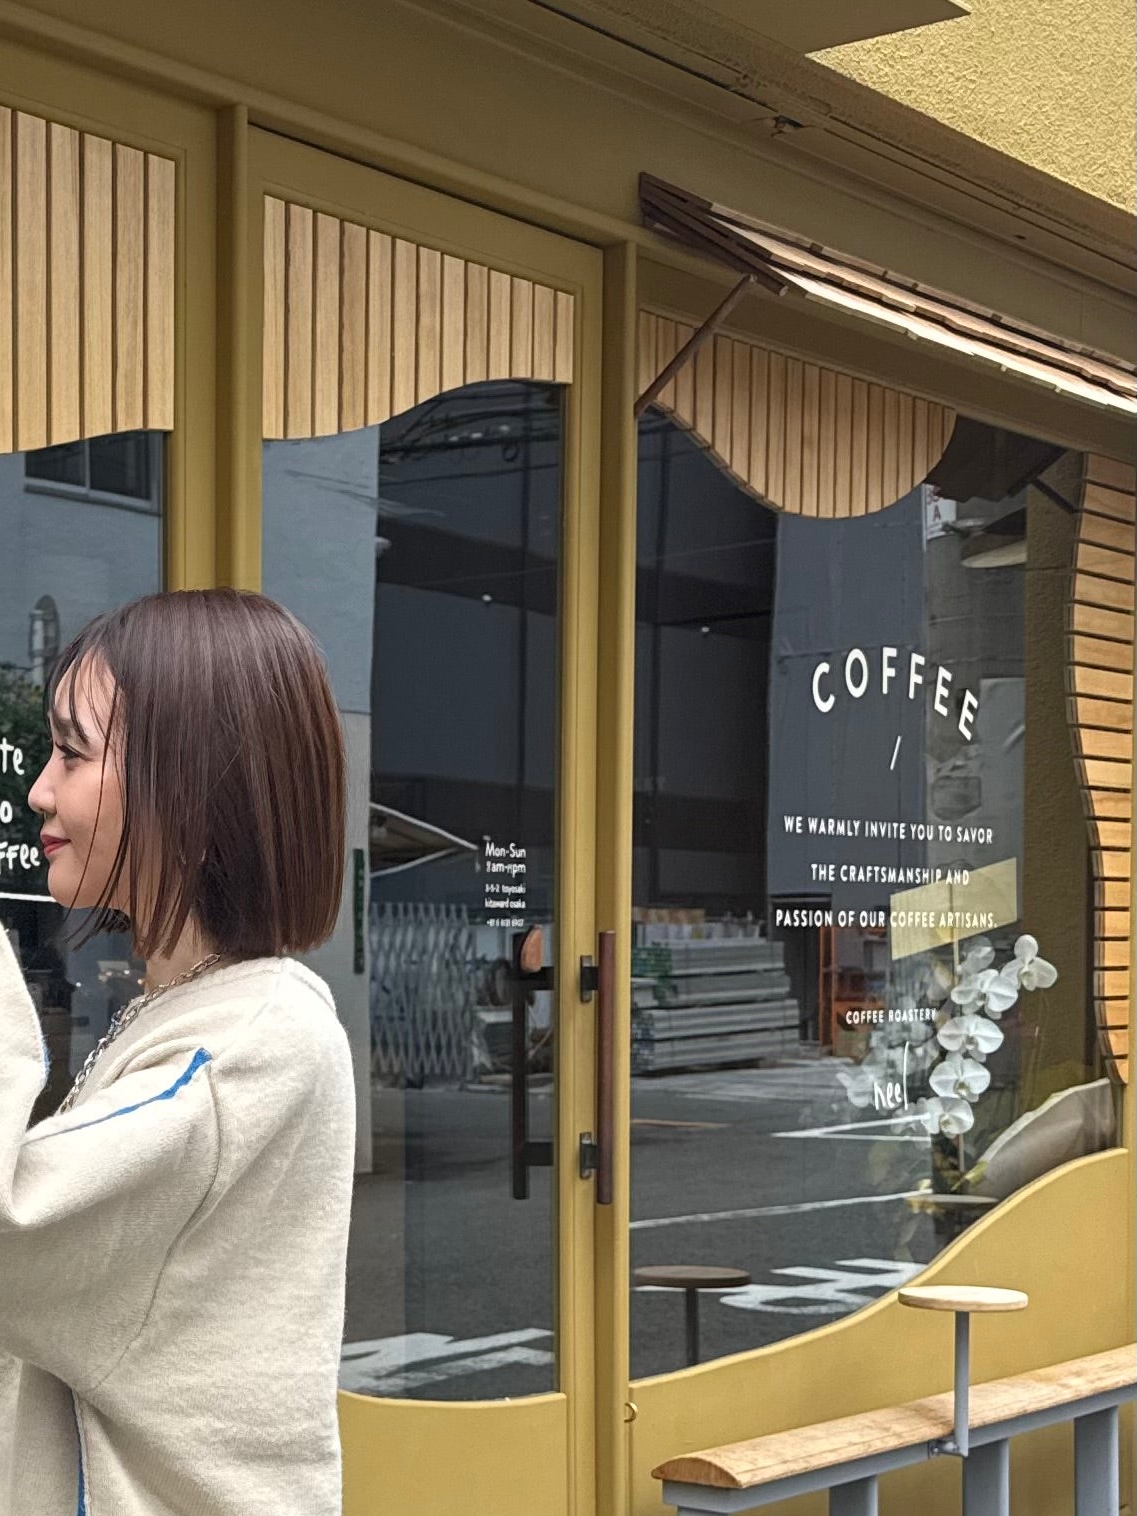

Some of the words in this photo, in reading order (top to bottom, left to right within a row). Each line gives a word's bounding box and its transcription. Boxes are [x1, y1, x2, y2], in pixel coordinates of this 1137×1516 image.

[812, 646, 979, 742] COFFEE
[784, 816, 803, 833] WE
[808, 817, 860, 837] WARMLY
[865, 821, 906, 839] INVITE
[910, 823, 933, 841] YOU
[938, 825, 952, 842] TO
[957, 827, 993, 844] SAVOR
[485, 842, 526, 858] Mon-Sun
[811, 864, 835, 881] THE
[840, 865, 941, 884] CRAFTSMANSHIP
[946, 870, 969, 885] AND
[776, 909, 833, 927] PASSION
[838, 910, 855, 927] OF
[859, 910, 885, 927] OUR
[890, 911, 935, 928] COFFEE
[939, 912, 997, 929] ARTISANS.
[845, 1010, 884, 1024] COFFEE
[889, 1008, 936, 1023] ROASTERY
[874, 1041, 910, 1110] neel
